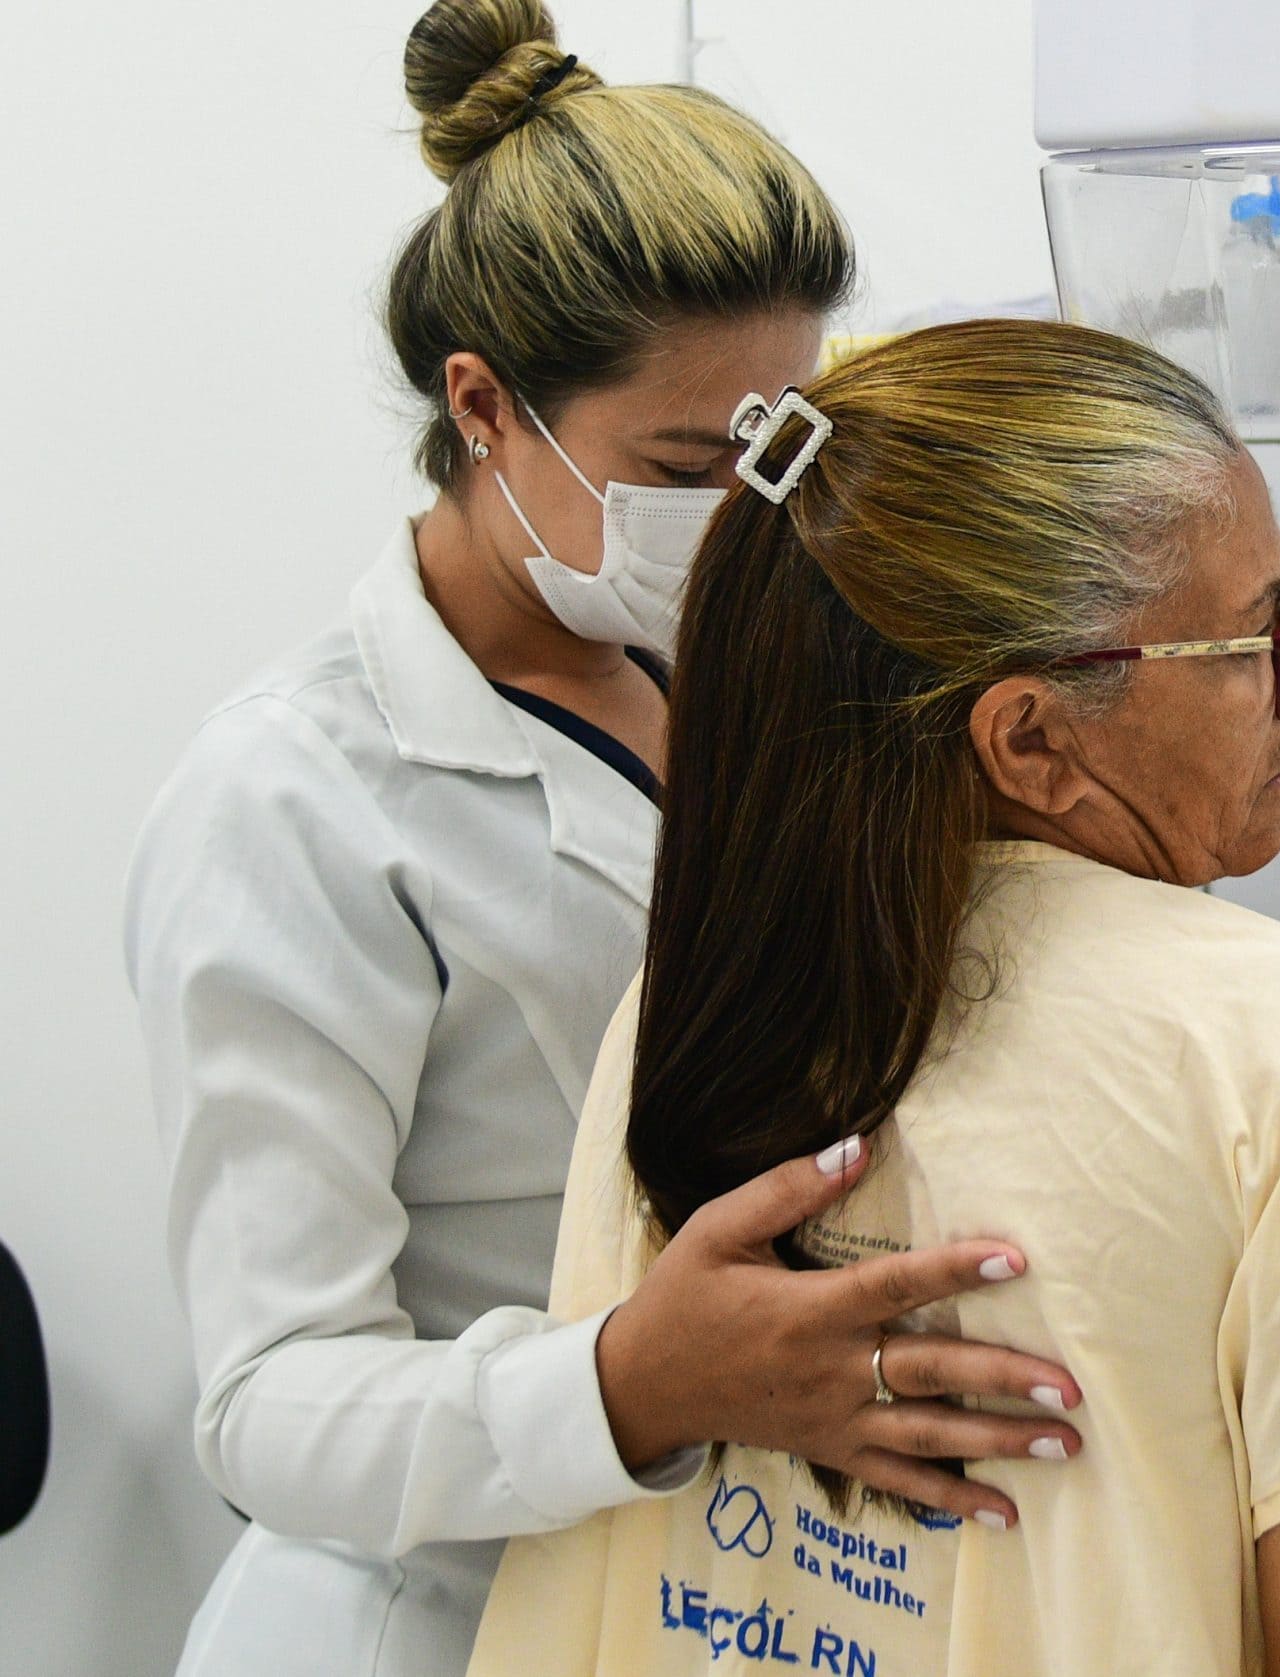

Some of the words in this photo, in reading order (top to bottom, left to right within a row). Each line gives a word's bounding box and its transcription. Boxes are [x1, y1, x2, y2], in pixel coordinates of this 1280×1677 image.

[796, 1504, 907, 1572] Hospital
[794, 1543, 822, 1577] da
[831, 1560, 926, 1618] Mulher
[811, 1625, 877, 1677] RN
